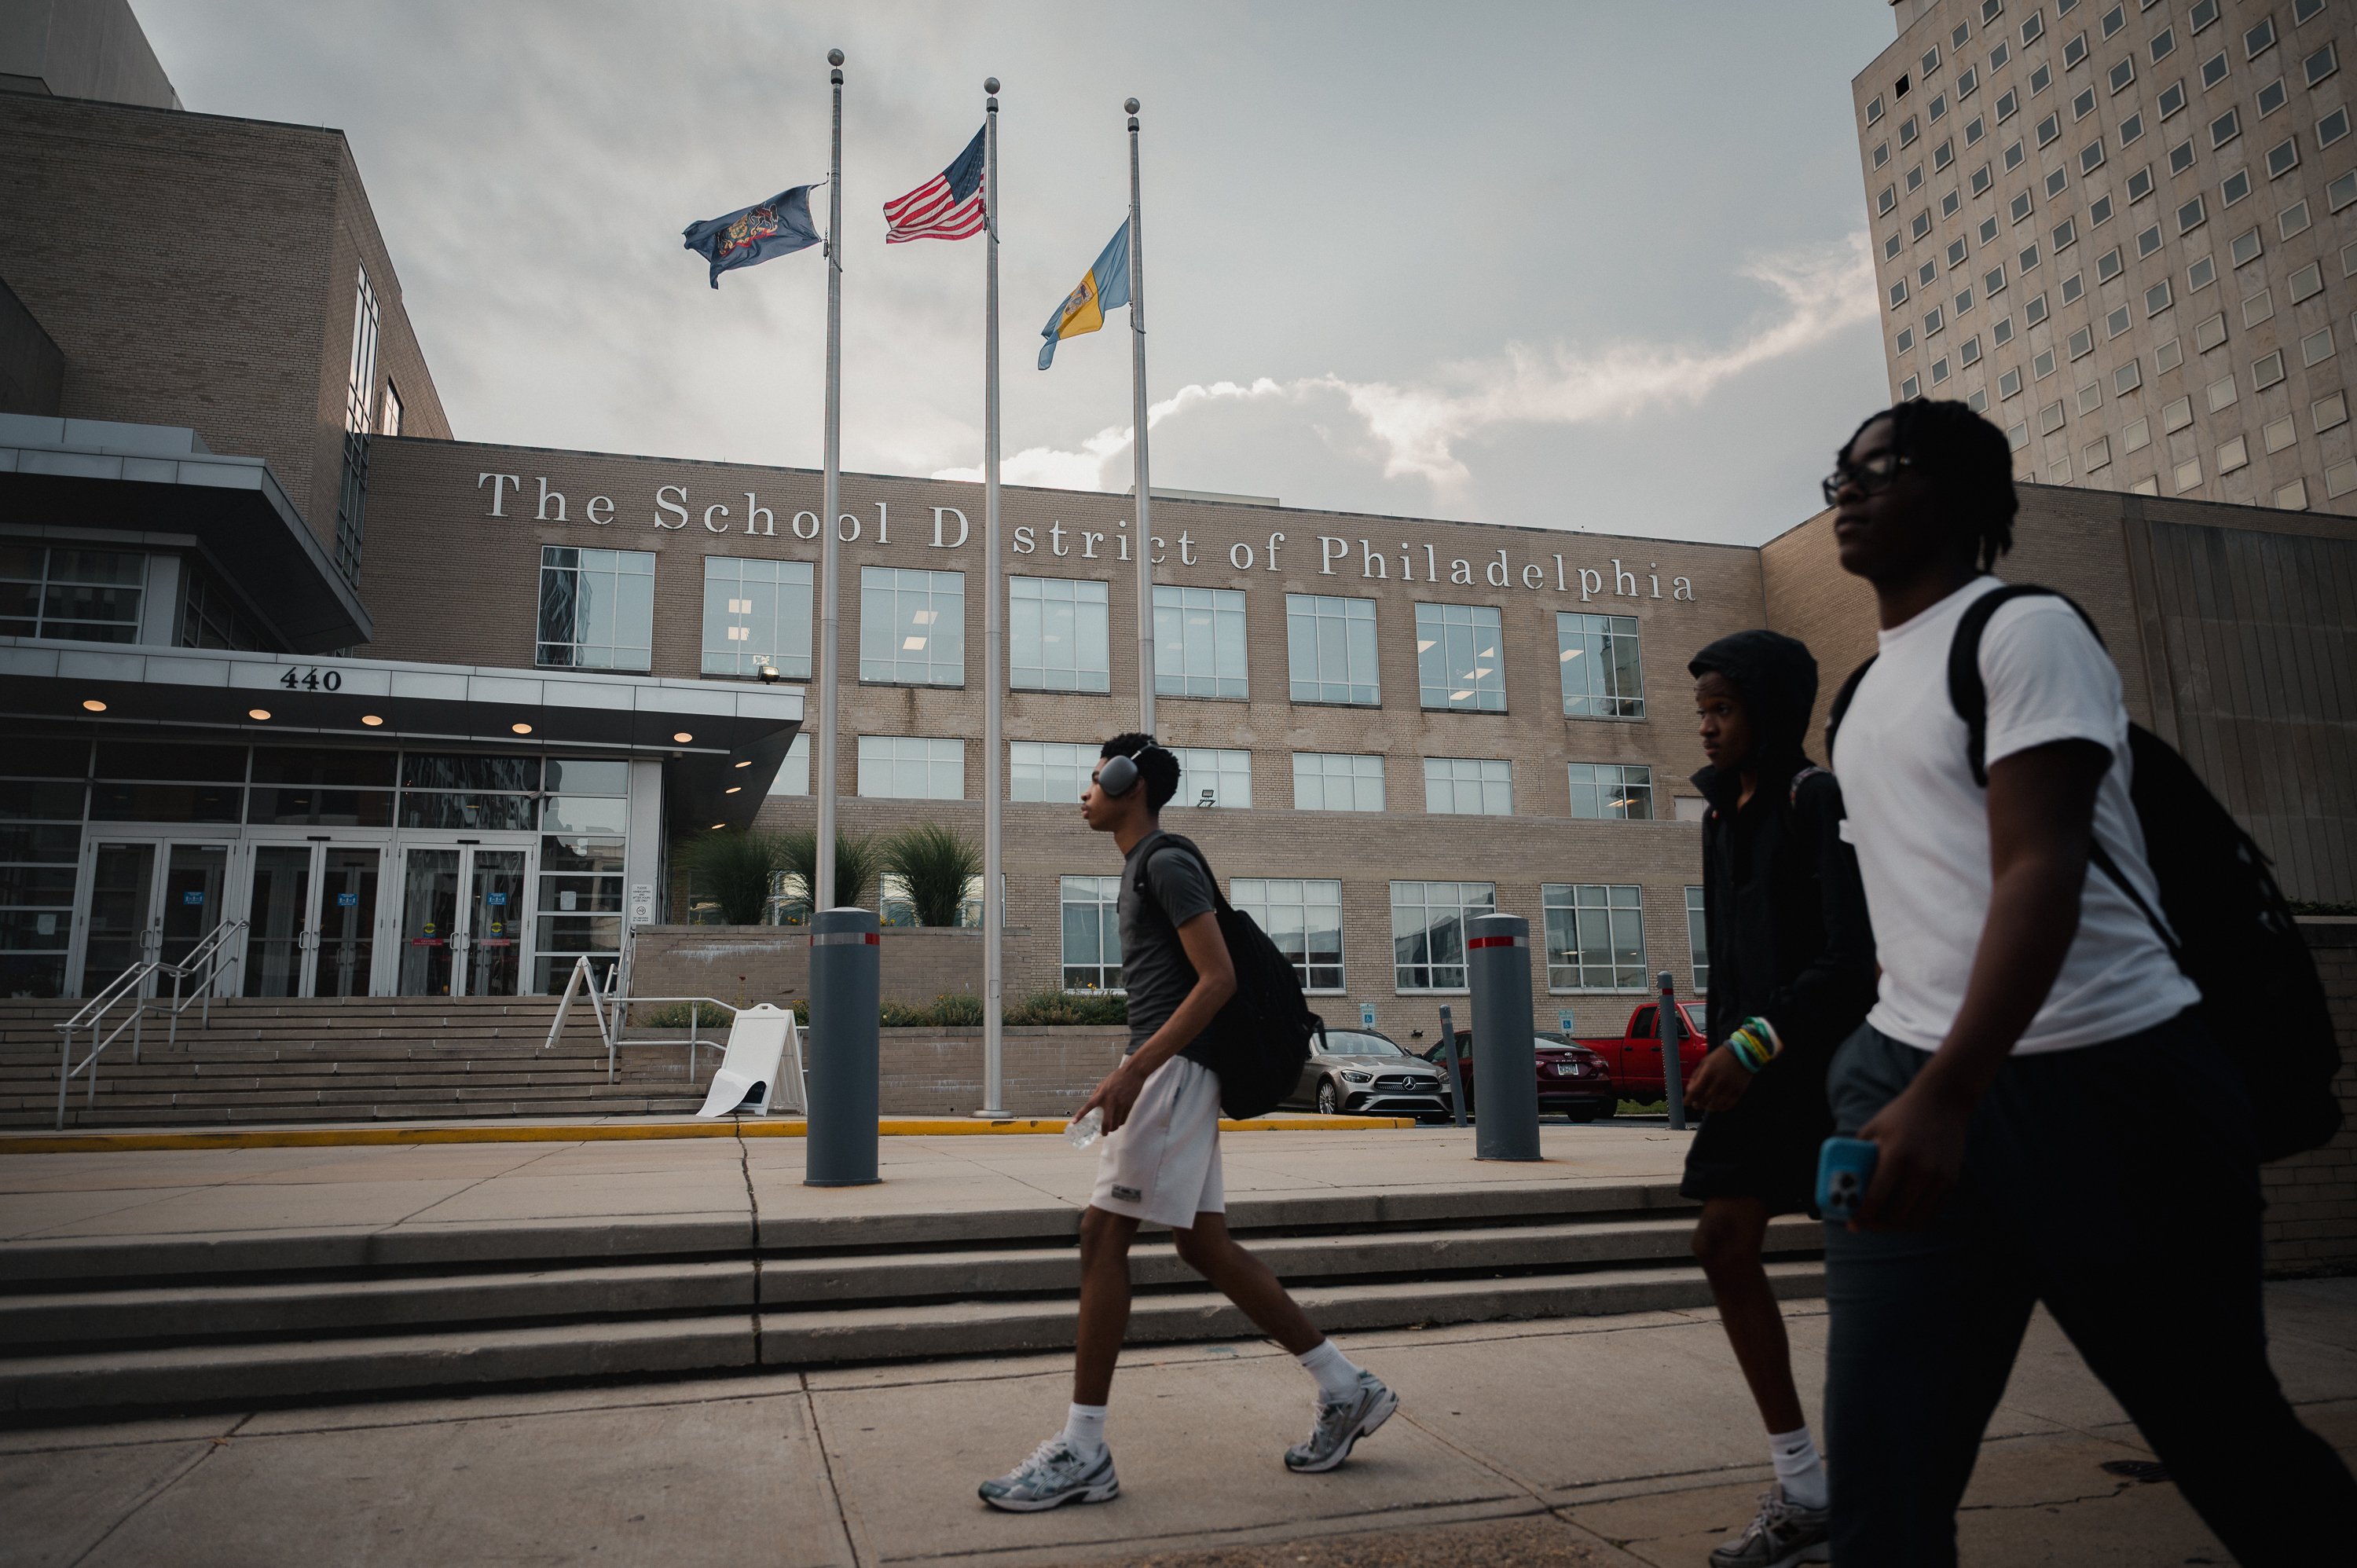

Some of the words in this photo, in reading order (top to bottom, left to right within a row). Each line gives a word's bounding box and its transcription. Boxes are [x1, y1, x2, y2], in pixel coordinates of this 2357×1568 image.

[478, 472, 615, 526] The
[654, 485, 892, 544] School
[928, 507, 1197, 566] Dstrict
[1230, 532, 1285, 571] of
[1316, 536, 1697, 603] Philadelphia
[280, 666, 342, 691] 440
